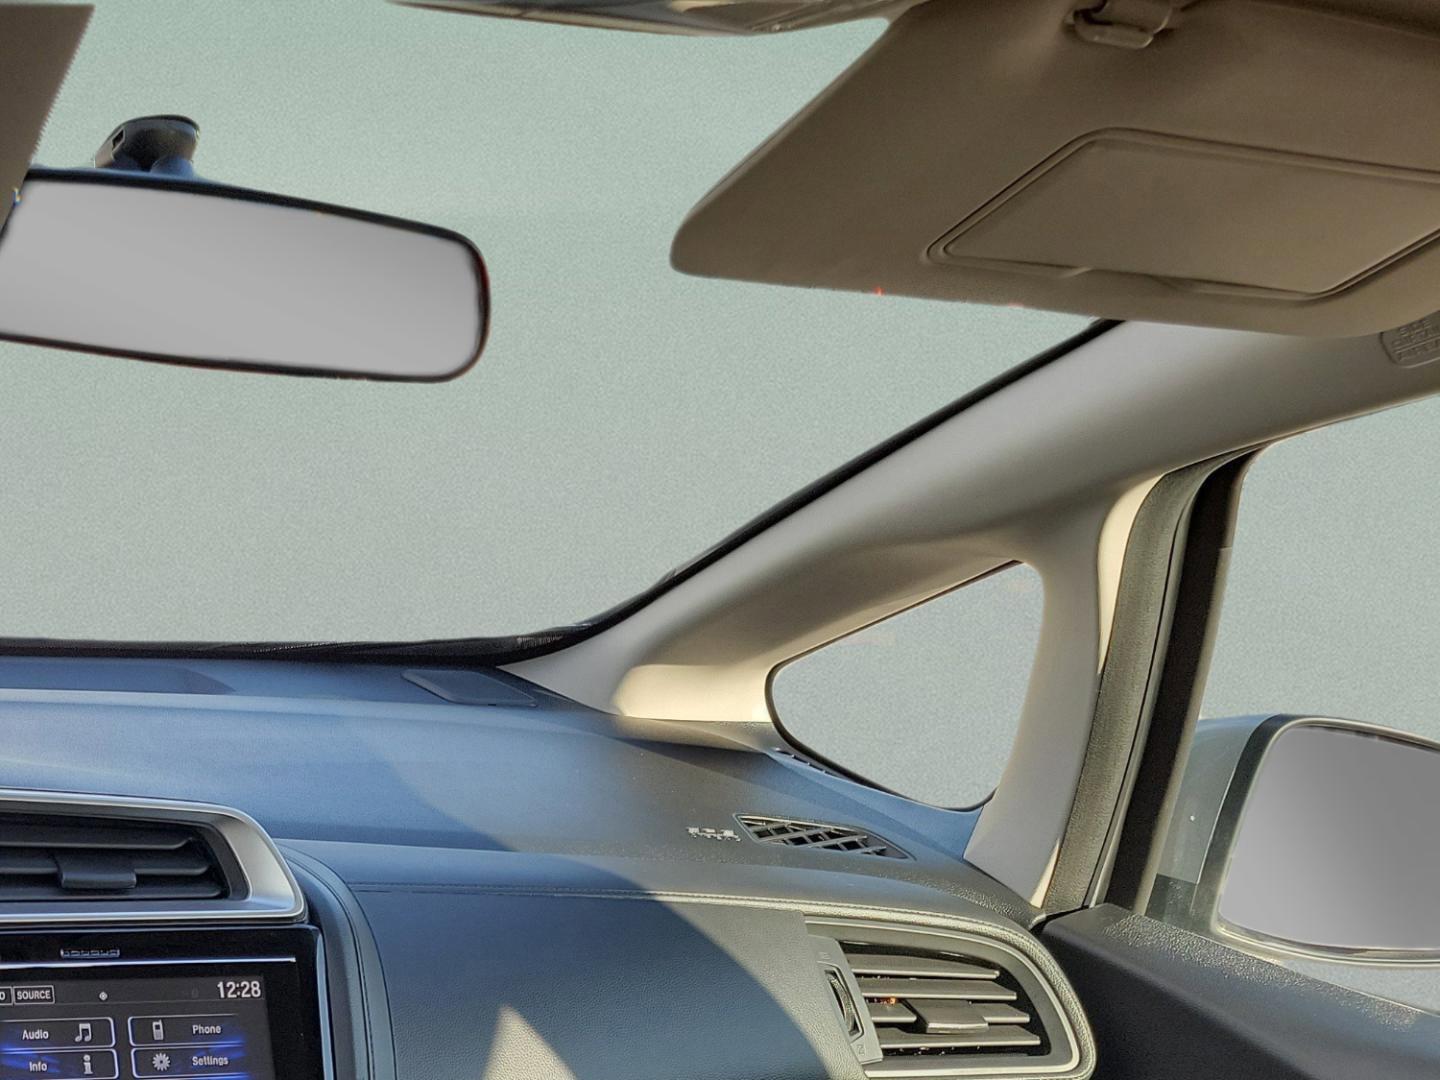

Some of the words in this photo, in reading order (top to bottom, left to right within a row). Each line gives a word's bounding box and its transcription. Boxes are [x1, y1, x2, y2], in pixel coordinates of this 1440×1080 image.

[16, 989, 52, 1001] SOURCE
[217, 981, 261, 999] 12:28
[21, 1028, 49, 1041] Audio
[192, 1023, 221, 1036] Phone
[29, 1060, 48, 1073] Info
[191, 1054, 229, 1068] Settings
